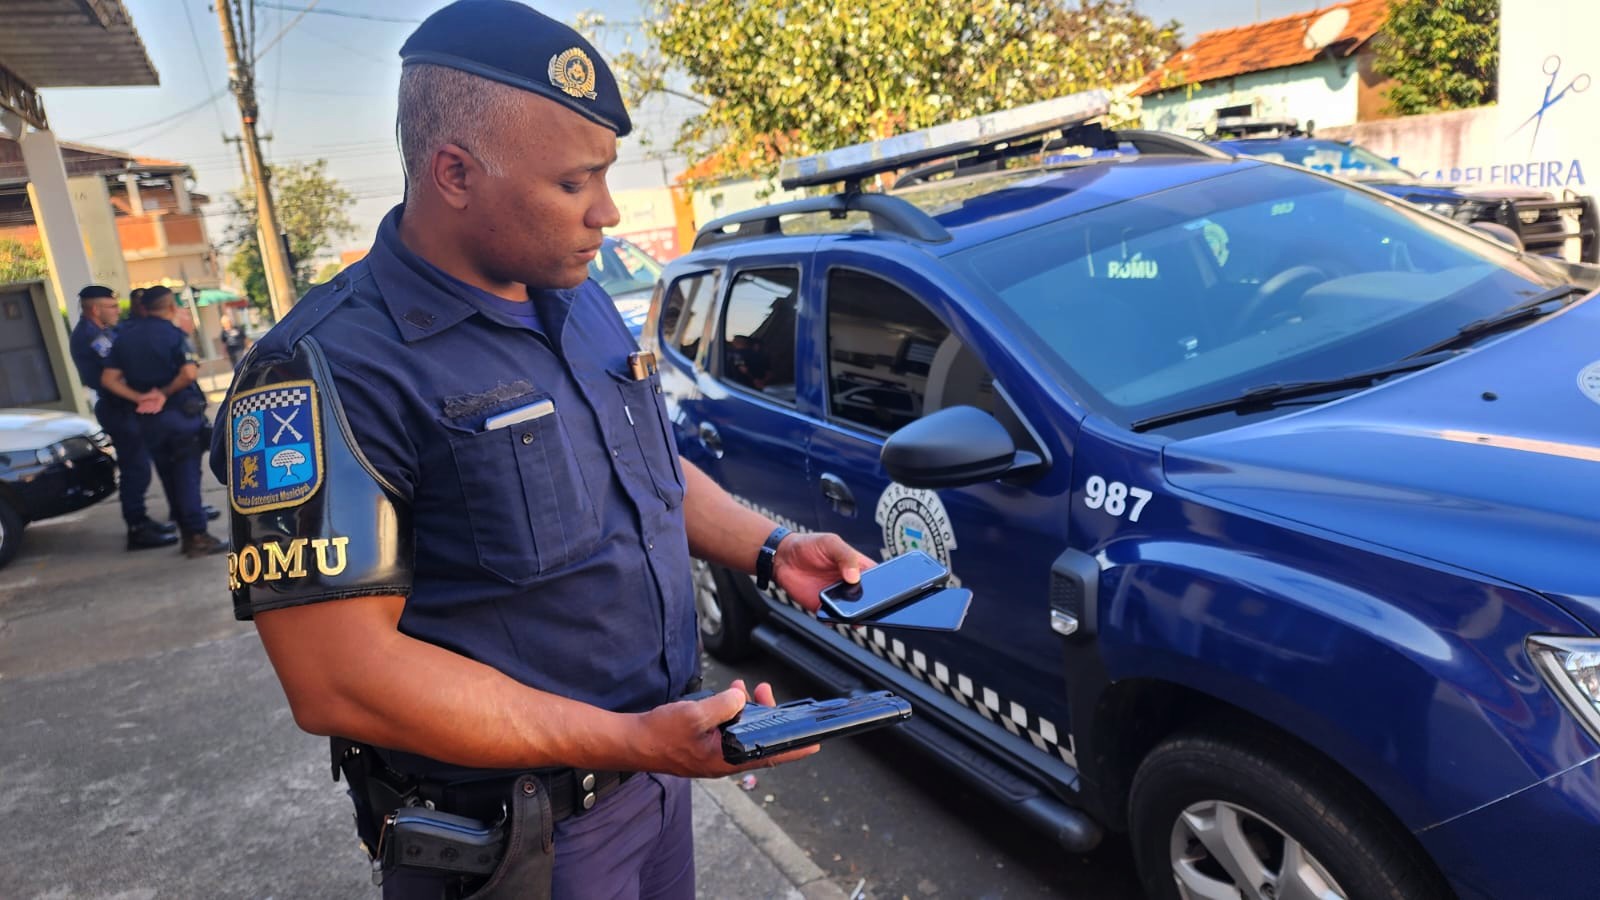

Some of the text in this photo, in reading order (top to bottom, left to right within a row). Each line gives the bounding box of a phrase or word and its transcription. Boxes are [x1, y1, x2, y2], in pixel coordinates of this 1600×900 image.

[897, 499, 918, 512] CIVIL
[1084, 475, 1153, 522] 987
[227, 537, 349, 591] ROMU
